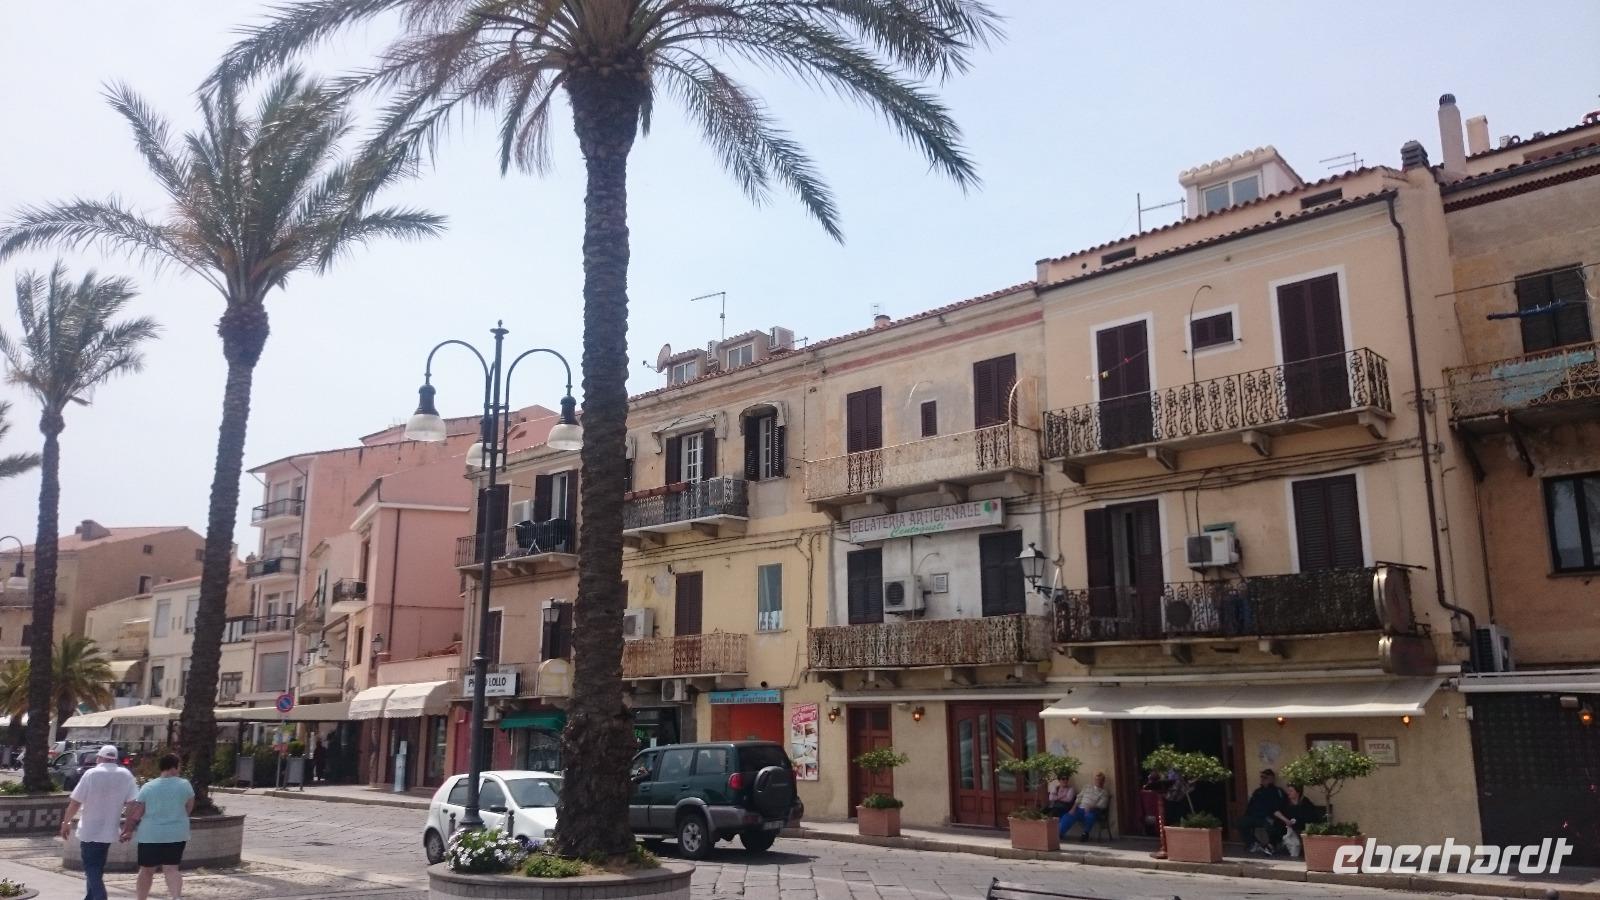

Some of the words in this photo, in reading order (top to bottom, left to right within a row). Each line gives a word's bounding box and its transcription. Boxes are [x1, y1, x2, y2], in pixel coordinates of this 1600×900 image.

[852, 517, 905, 534] GELATERIA
[909, 503, 981, 526] ARTIGIANALE
[488, 676, 507, 687] LOLLO
